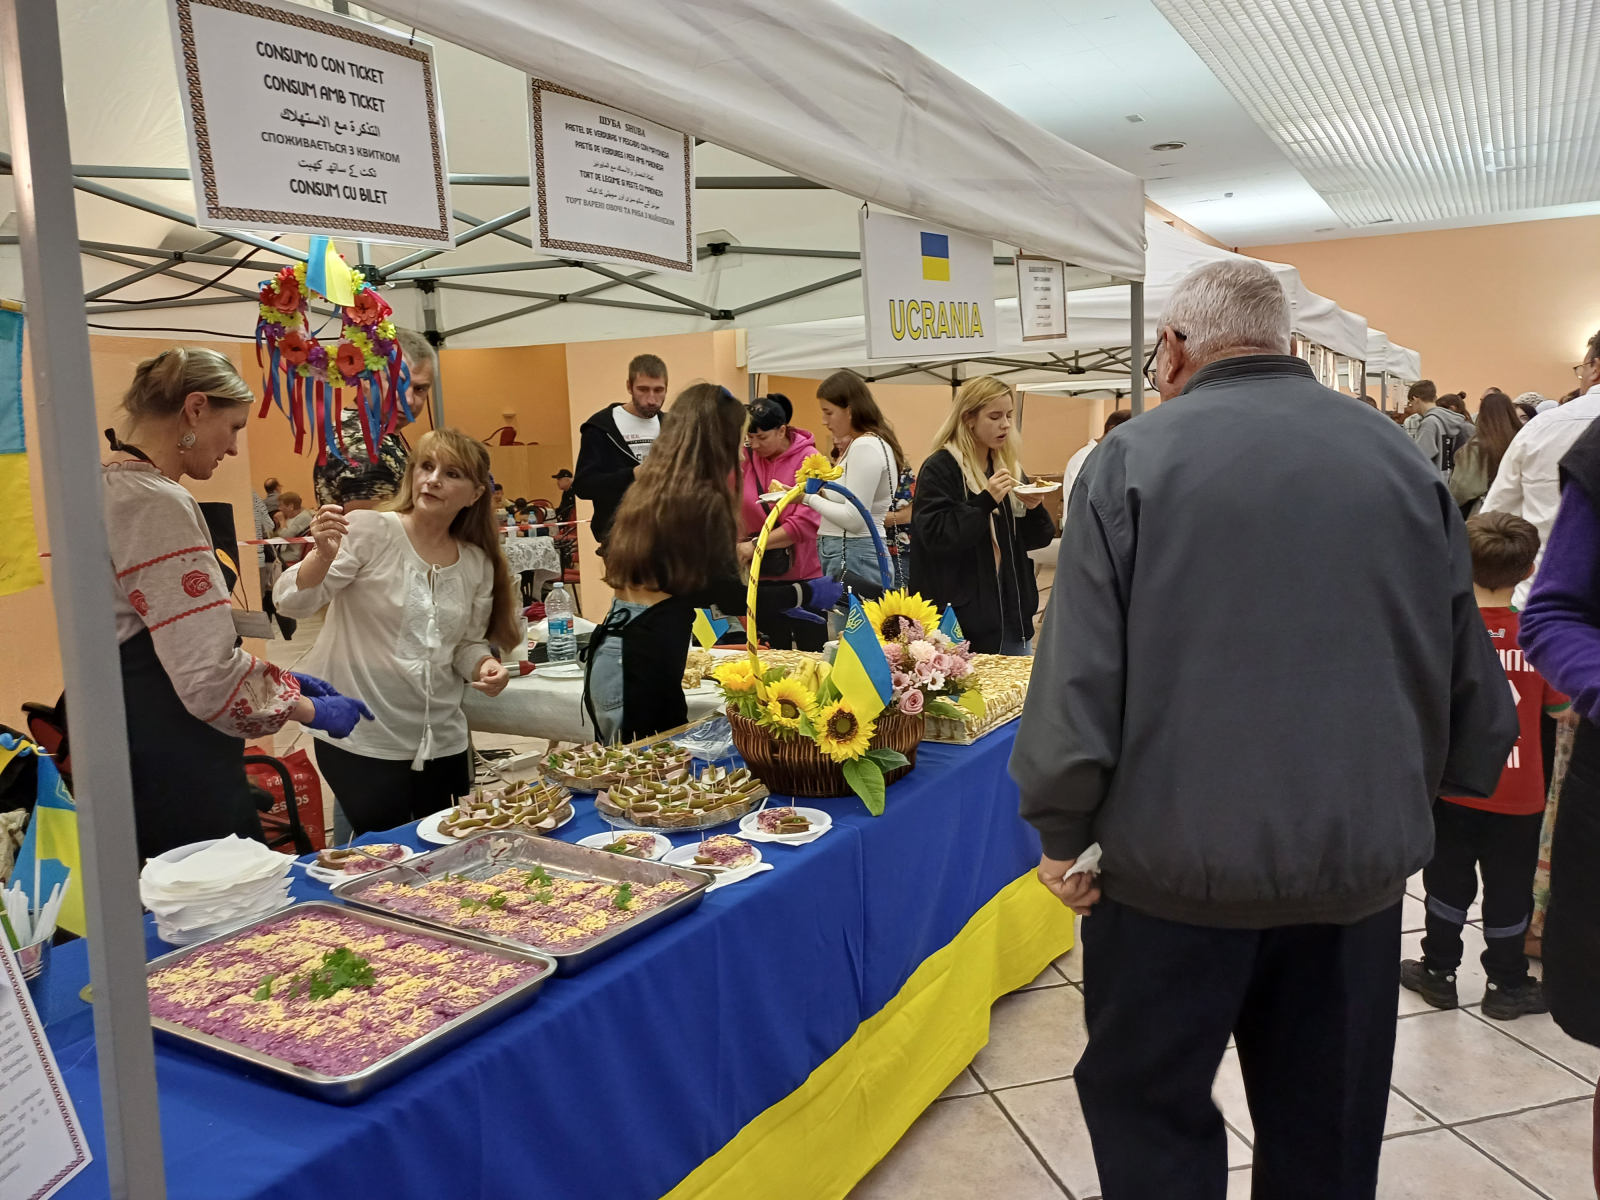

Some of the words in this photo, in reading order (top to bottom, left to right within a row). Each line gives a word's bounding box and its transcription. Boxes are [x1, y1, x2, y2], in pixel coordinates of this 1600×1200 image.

[256, 41, 318, 69] CONSUMO
[321, 56, 346, 75] CON
[348, 62, 384, 84] TICKET
[264, 74, 317, 99] CONSUM
[320, 85, 347, 104] AMB
[349, 92, 385, 113] TICKET
[334, 121, 348, 135] مع
[565, 122, 585, 135] PASTEL
[586, 127, 593, 136] DE
[599, 115, 621, 130] ШУБА
[625, 123, 646, 138] SHUBA
[261, 131, 348, 154] СПОЖИВАЄТЬСЯ
[356, 147, 401, 164] КВИТКОМ
[594, 145, 601, 153] DE
[579, 169, 594, 180] TORT
[595, 173, 602, 182] DE
[290, 179, 341, 199] CONSUM
[343, 185, 357, 201] CU
[359, 188, 388, 205] BILET
[565, 196, 582, 205] ТОРТ
[889, 299, 984, 340] UCRANIA
